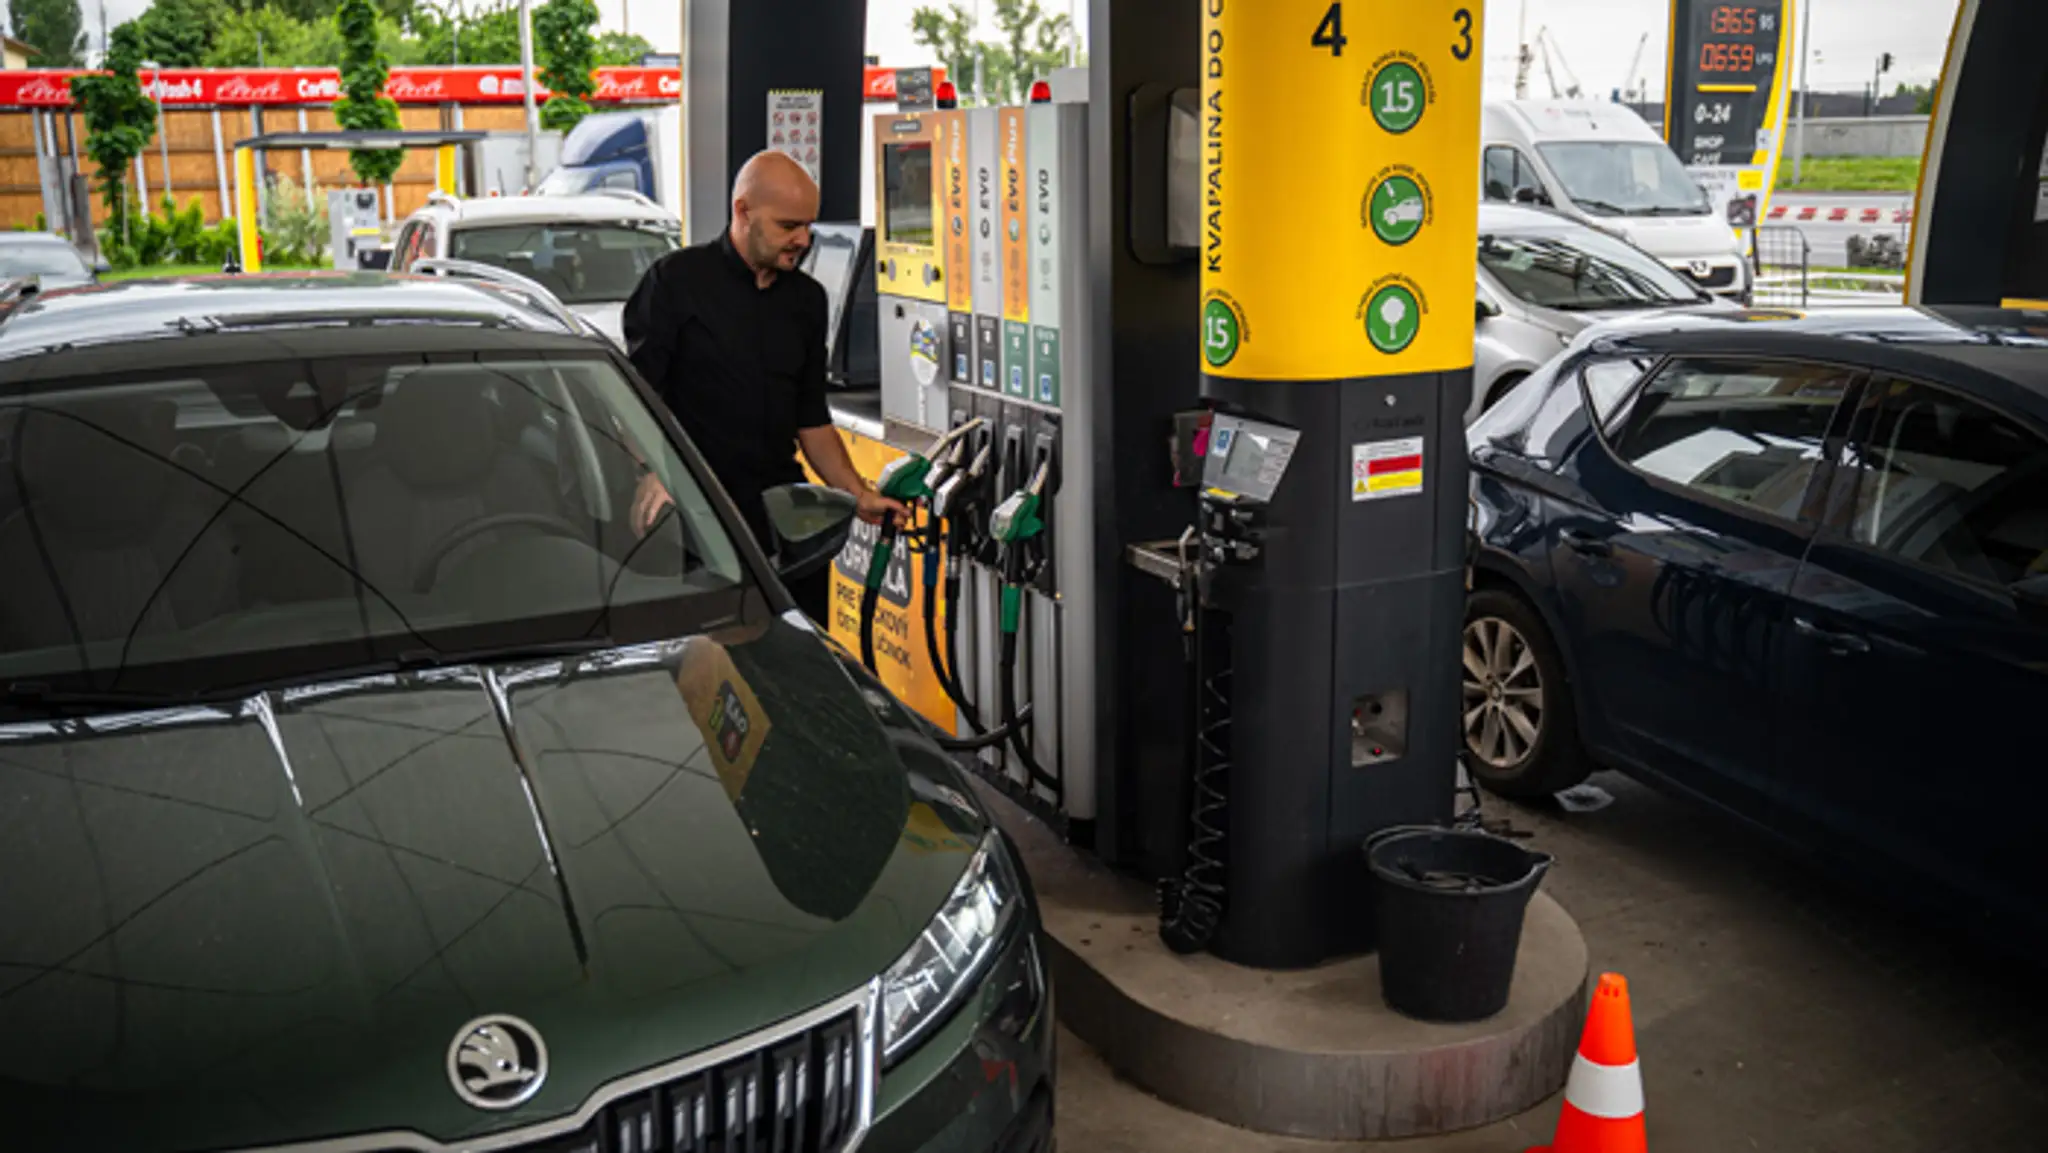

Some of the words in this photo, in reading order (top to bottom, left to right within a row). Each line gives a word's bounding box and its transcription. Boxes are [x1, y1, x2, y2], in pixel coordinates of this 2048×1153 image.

[1311, 2, 1347, 57] 4
[1451, 8, 1473, 61] 3
[1711, 6, 1757, 34] 1365
[1208, 29, 1224, 78] DO
[1700, 43, 1755, 71] 0659
[1381, 81, 1415, 113] 15
[1694, 103, 1731, 123] 0-24
[951, 120, 961, 164] Plus
[1007, 116, 1018, 165] Plus
[1694, 135, 1724, 149] SHOP
[952, 167, 961, 208] EVO
[978, 167, 990, 210] EVO
[1008, 168, 1019, 212] EVO
[1038, 169, 1050, 214] EVO
[1207, 90, 1223, 272] KVAPALINA
[1206, 317, 1230, 349] 15
